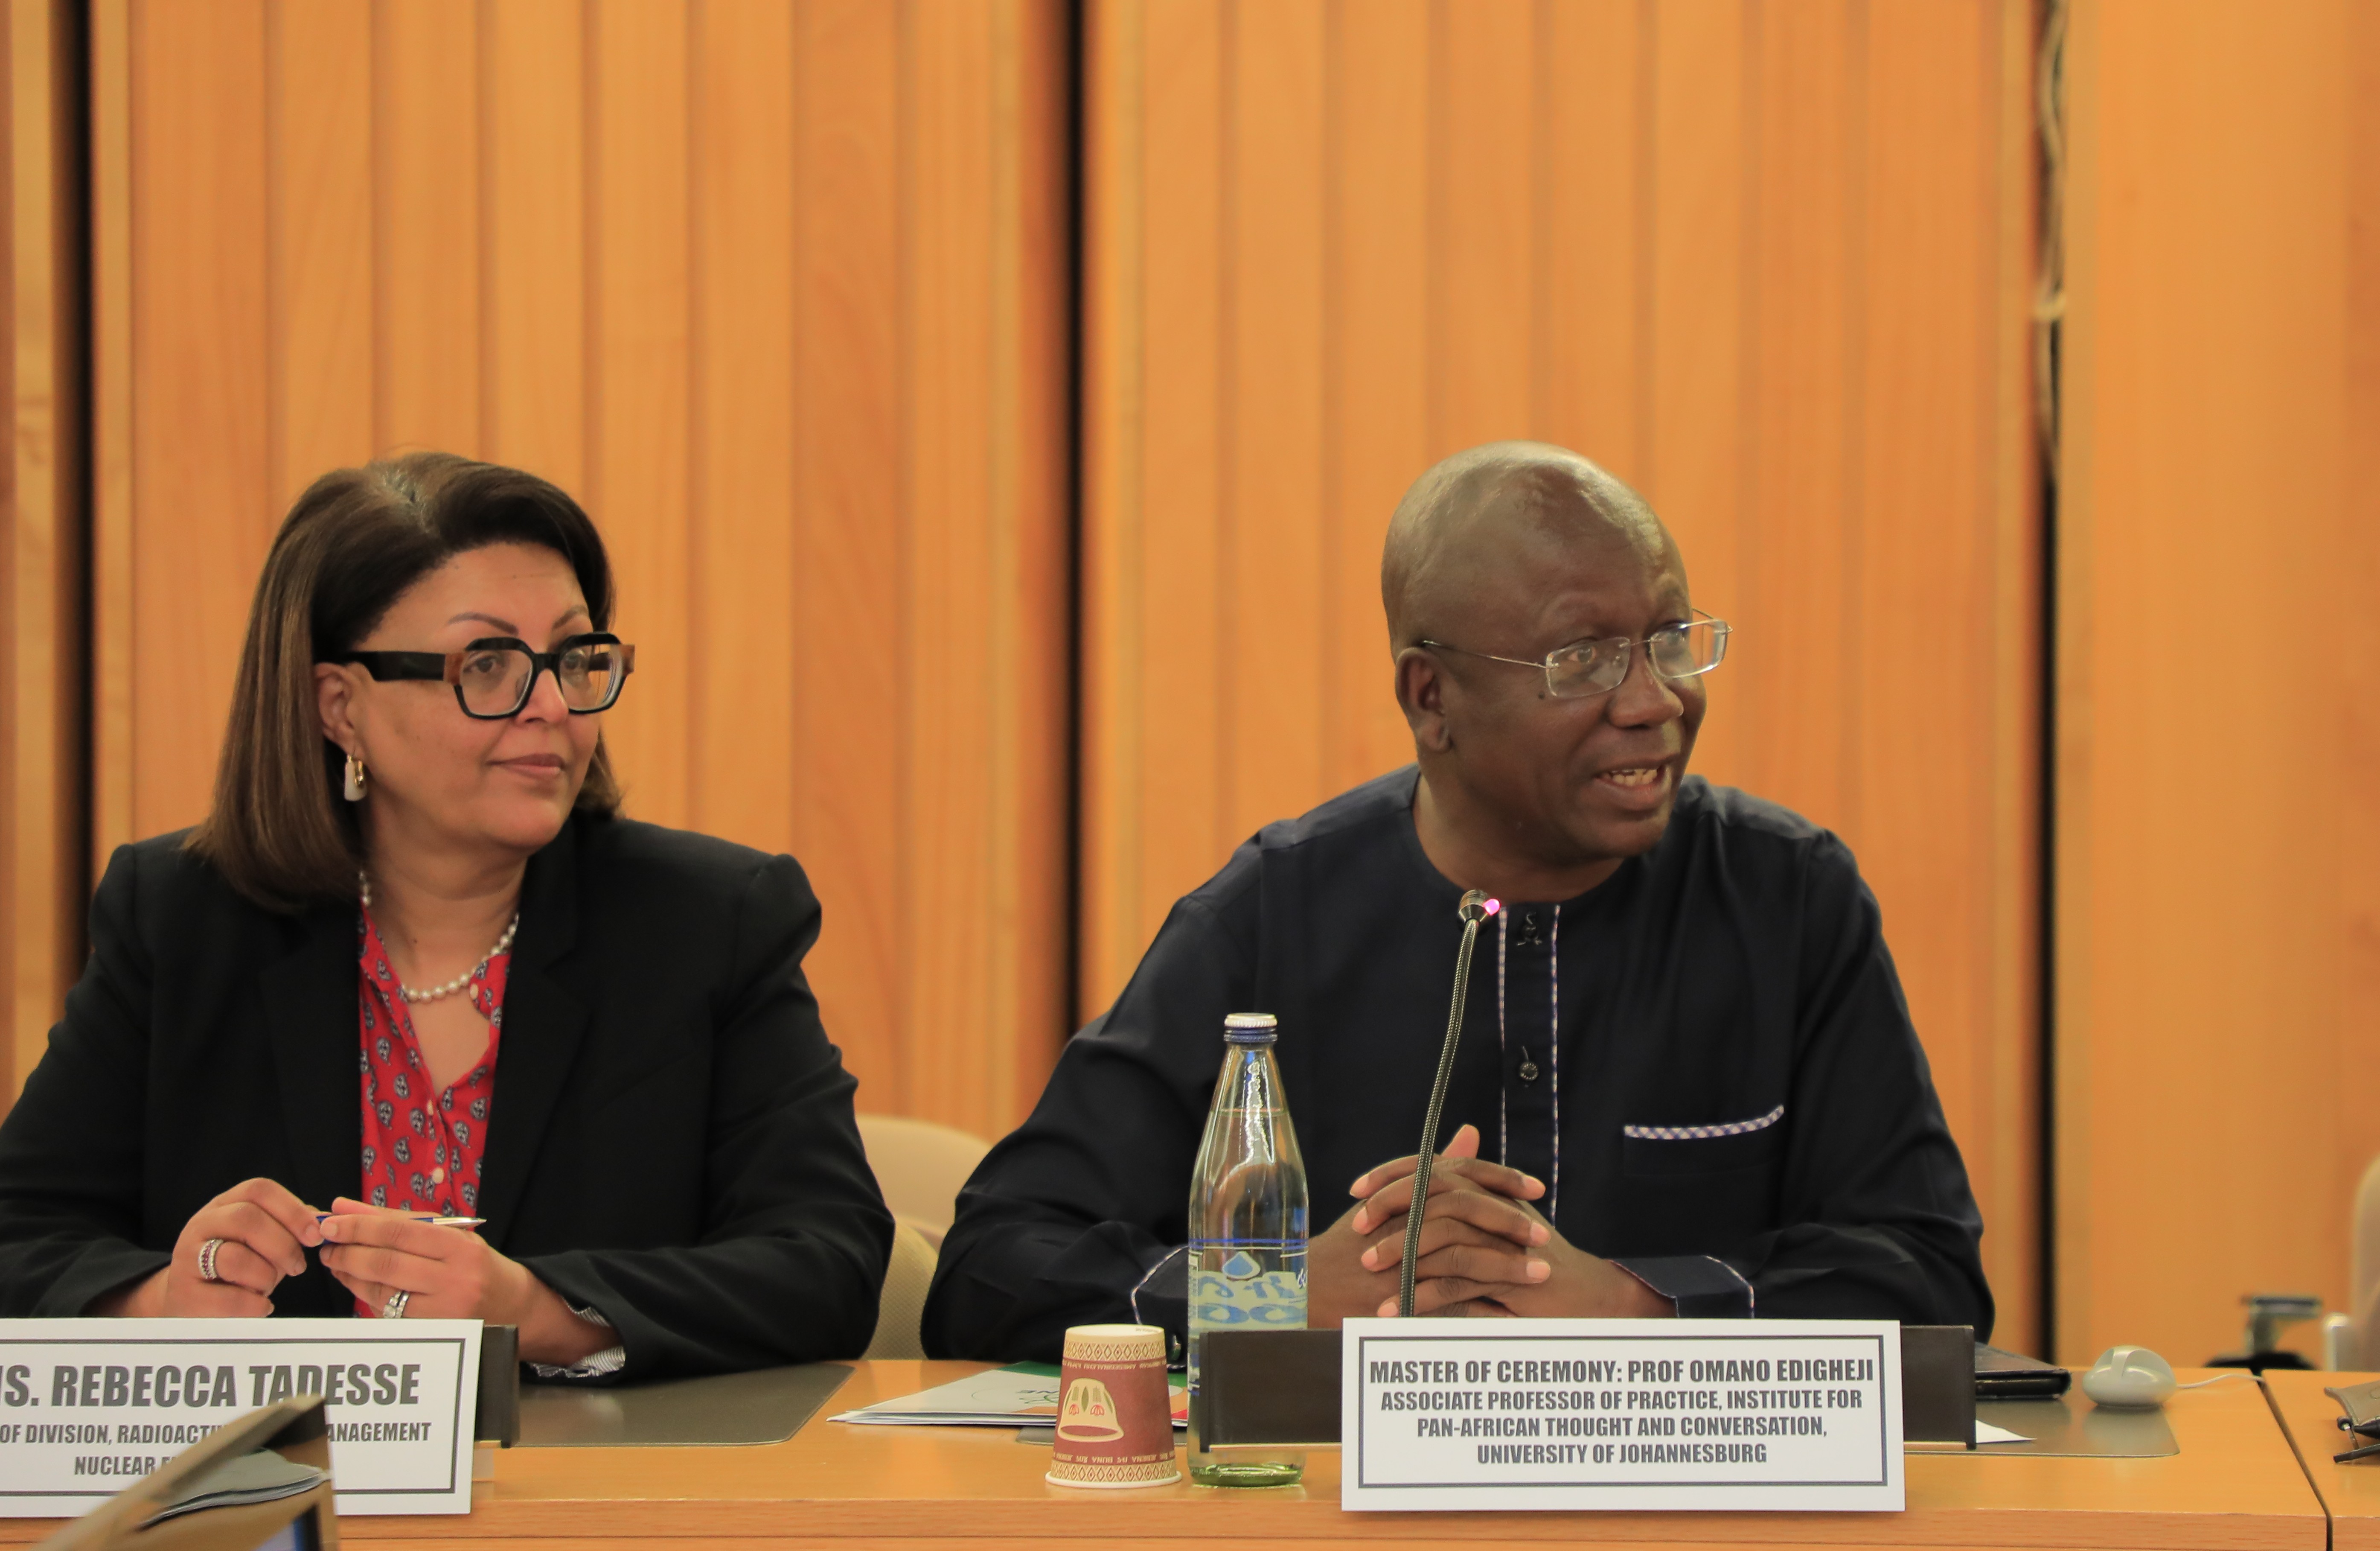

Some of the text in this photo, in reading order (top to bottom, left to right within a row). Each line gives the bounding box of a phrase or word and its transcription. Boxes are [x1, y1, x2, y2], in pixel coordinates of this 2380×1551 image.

[1370, 1359, 1874, 1384] MASTER OF CEREMONY: PROF OMANO EDIGHEJI
[0, 1364, 421, 1408] S. REBECCA TADESSE
[1382, 1390, 1862, 1411] ASSOCIATE PROFESSOR OF PRACTICE, INSTITUTE FOR
[0, 1422, 432, 1446] OF DIVISION, RADIOACT ANAGEMENT
[1418, 1417, 1827, 1437] PAN-AFRICAN THOUGHT AND CONVERSATION,
[1478, 1444, 1767, 1464] UNIVERSITY OF JOHANNESBURG
[74, 1456, 156, 1475] NUCLEAR
